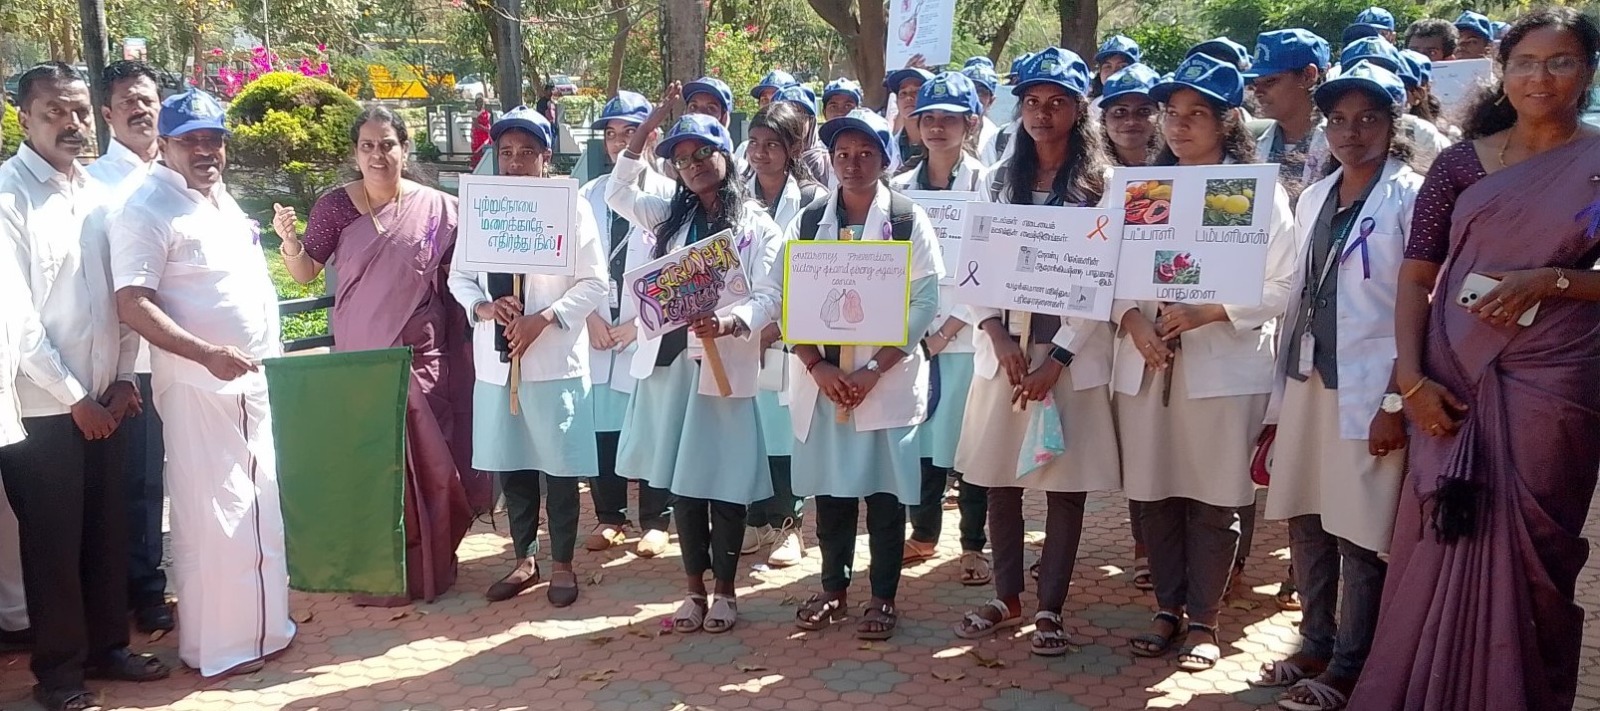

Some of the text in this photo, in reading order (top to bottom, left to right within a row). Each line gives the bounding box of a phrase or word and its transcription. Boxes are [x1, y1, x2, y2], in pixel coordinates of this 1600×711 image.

[473, 195, 538, 217] புற்றுநோயை
[488, 231, 531, 253] எதிர்த்து
[1122, 227, 1270, 245] பப்பாளி பம்பளிமாஸ்
[1156, 287, 1216, 301] மாதுளை
